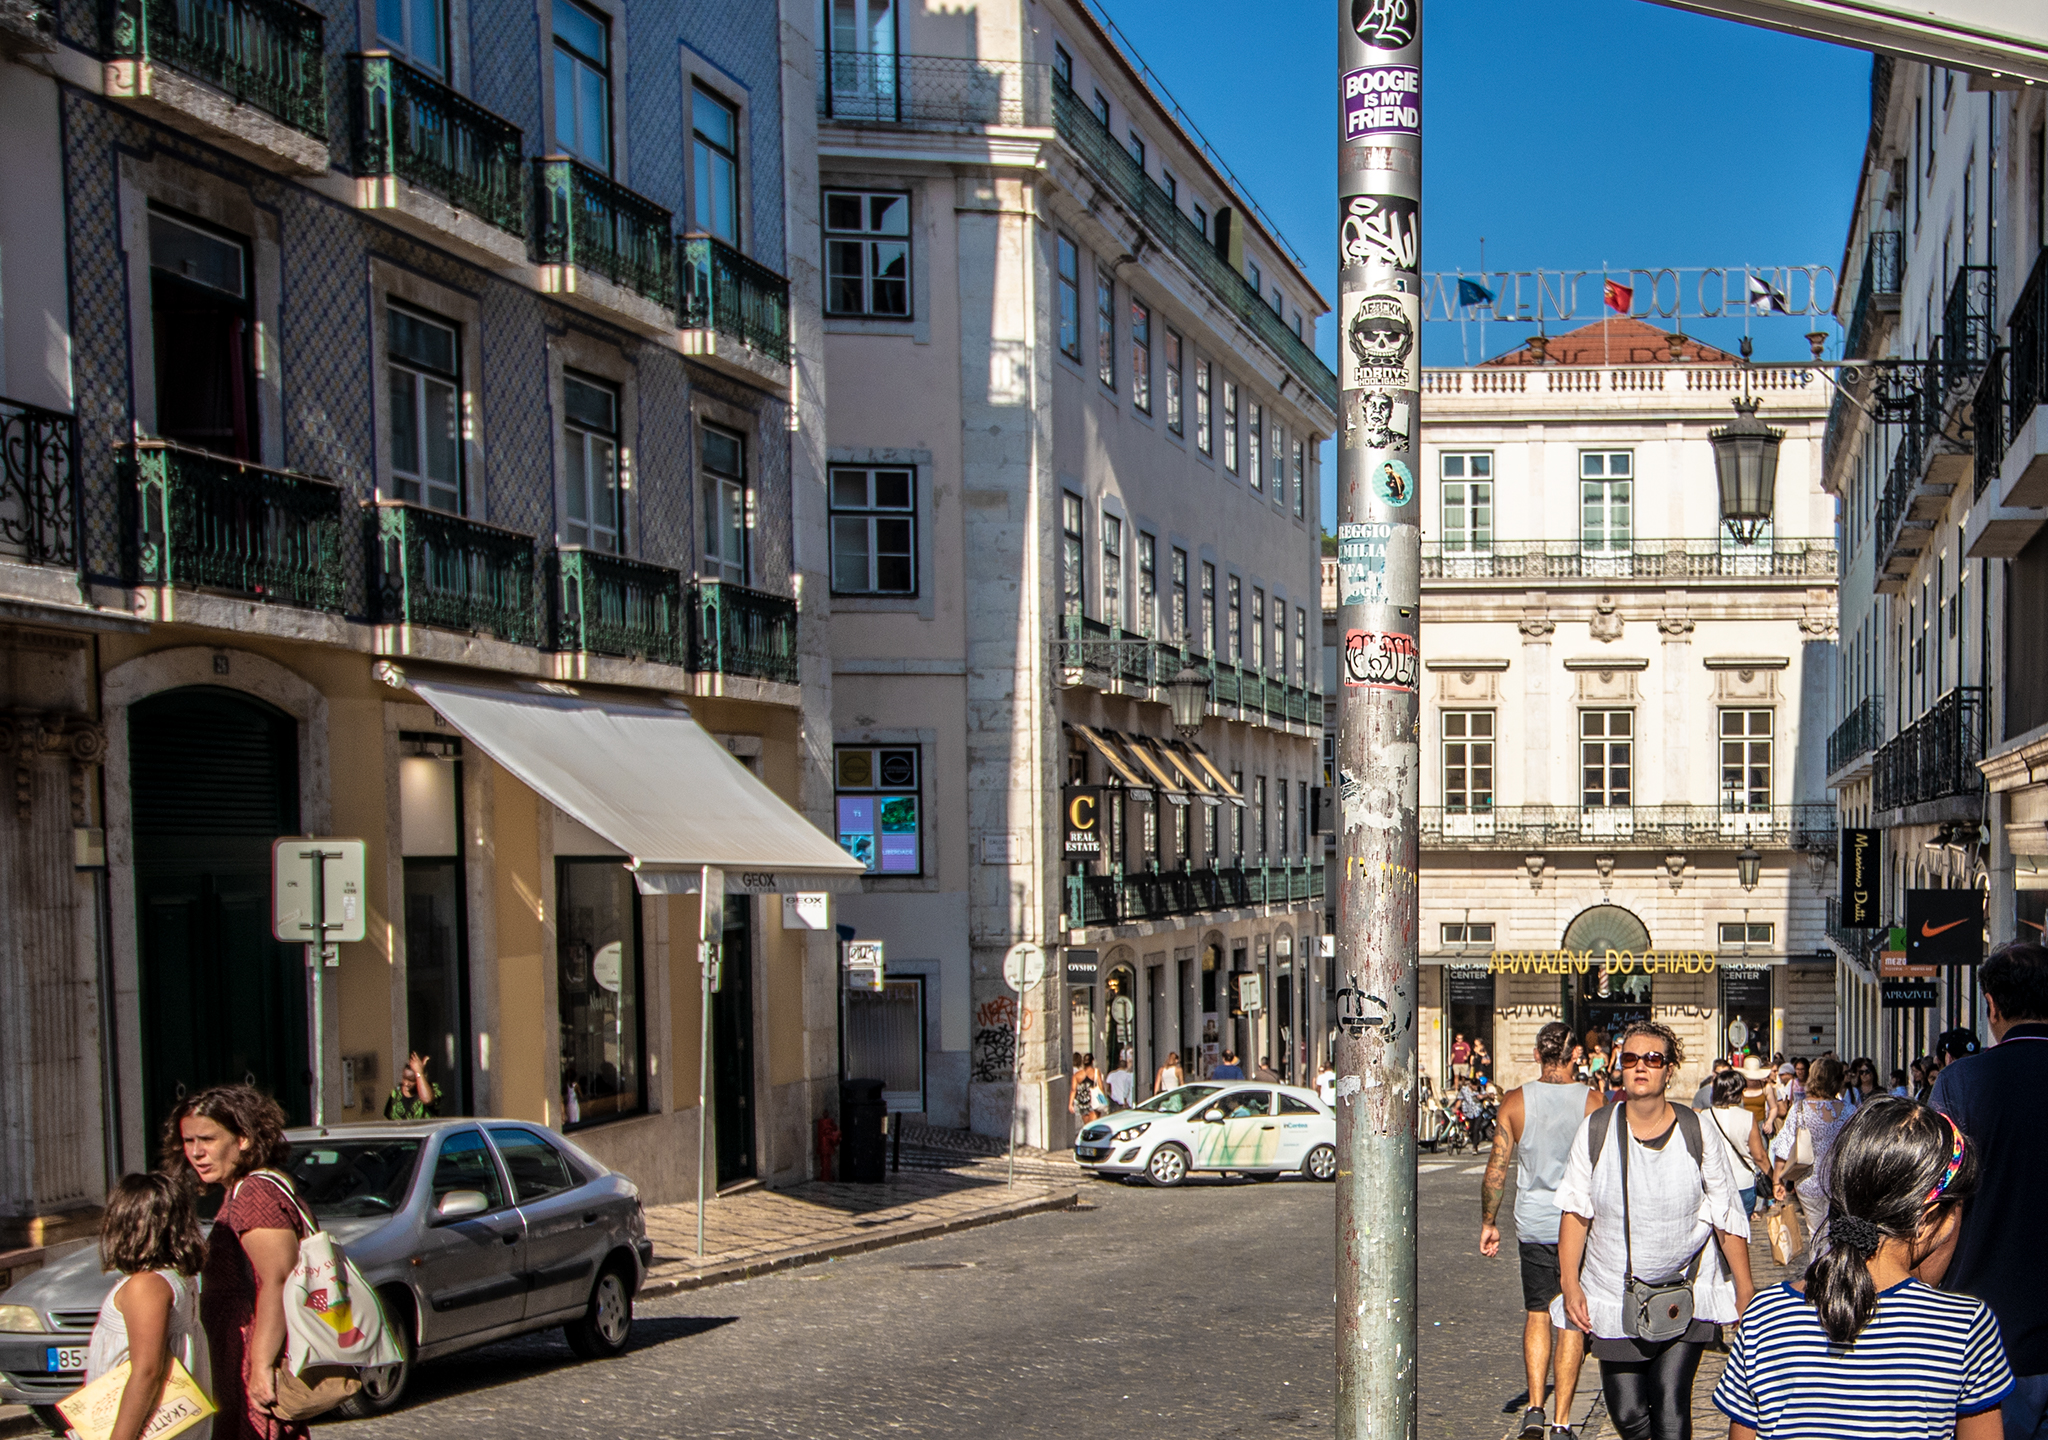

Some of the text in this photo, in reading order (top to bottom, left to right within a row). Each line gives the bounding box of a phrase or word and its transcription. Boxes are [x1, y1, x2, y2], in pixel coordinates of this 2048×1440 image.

[1346, 70, 1418, 99] BOOGIE
[1363, 92, 1404, 108] IS MY
[1348, 106, 1419, 133] FRIEND
[1629, 268, 1680, 319] DO
[1358, 378, 1406, 387] HOOLIGANS
[1338, 524, 1391, 539] REGGIO
[1069, 795, 1095, 830] C
[1069, 831, 1095, 842] REAL
[1065, 841, 1100, 852] ESTATE
[742, 872, 776, 888] GEOX
[1854, 833, 1869, 923] Massimo Dutti
[1067, 963, 1097, 972] OYSHO
[1605, 949, 1634, 974] DO
[1642, 950, 1716, 974] CHIADO
[1450, 971, 1487, 980] CENTER
[1724, 971, 1760, 980] CENTER
